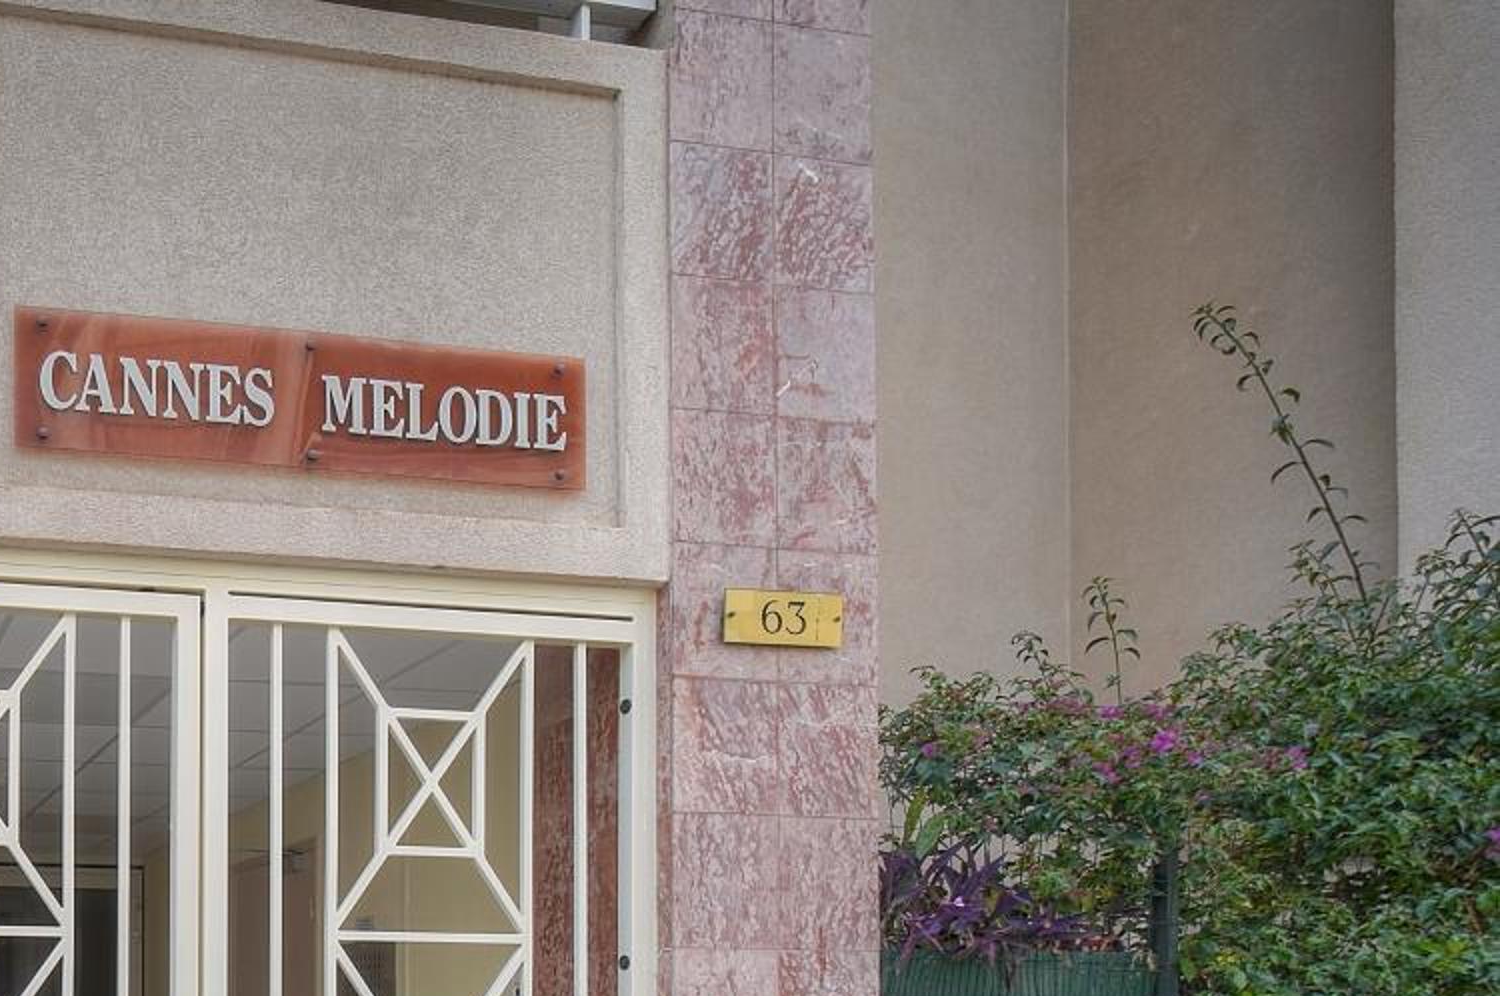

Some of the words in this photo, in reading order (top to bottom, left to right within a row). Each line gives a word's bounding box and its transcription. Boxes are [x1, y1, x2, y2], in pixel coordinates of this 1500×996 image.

[38, 350, 275, 427] CANNES
[321, 374, 567, 452] MELODIE
[761, 600, 807, 635] 63
